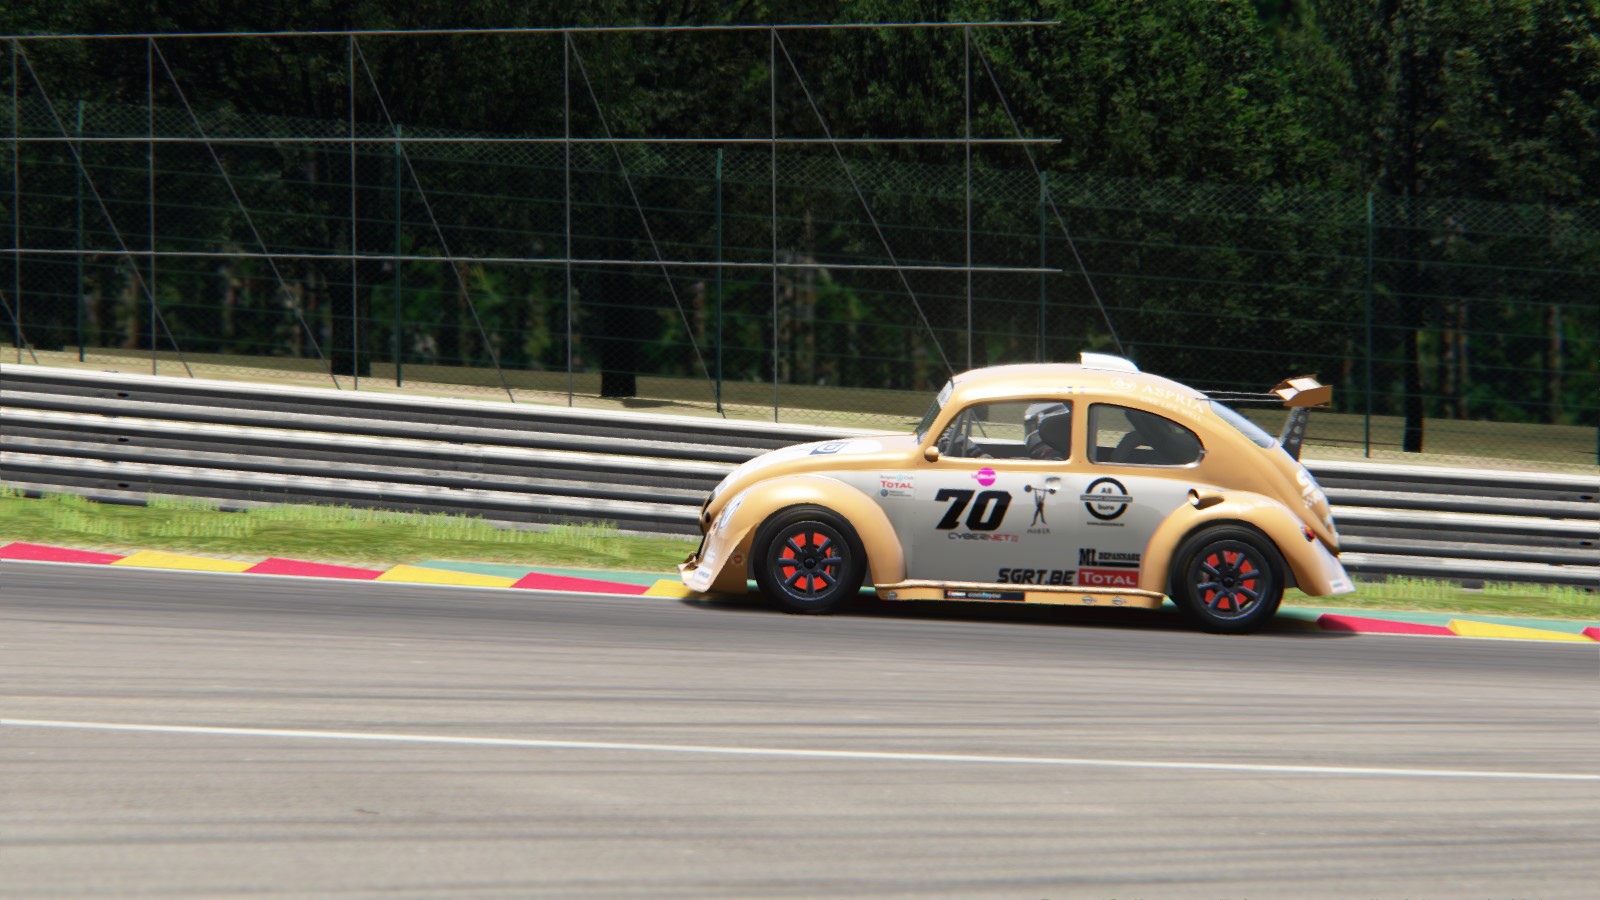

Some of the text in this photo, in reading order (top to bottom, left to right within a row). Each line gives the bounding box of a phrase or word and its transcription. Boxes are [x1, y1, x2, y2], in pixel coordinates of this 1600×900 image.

[1143, 384, 1204, 414] ASPRIA
[880, 480, 913, 489] TOTAL
[935, 488, 1013, 531] 70
[997, 568, 1077, 586] SGRT.BE
[1081, 571, 1137, 586] TOTAL
